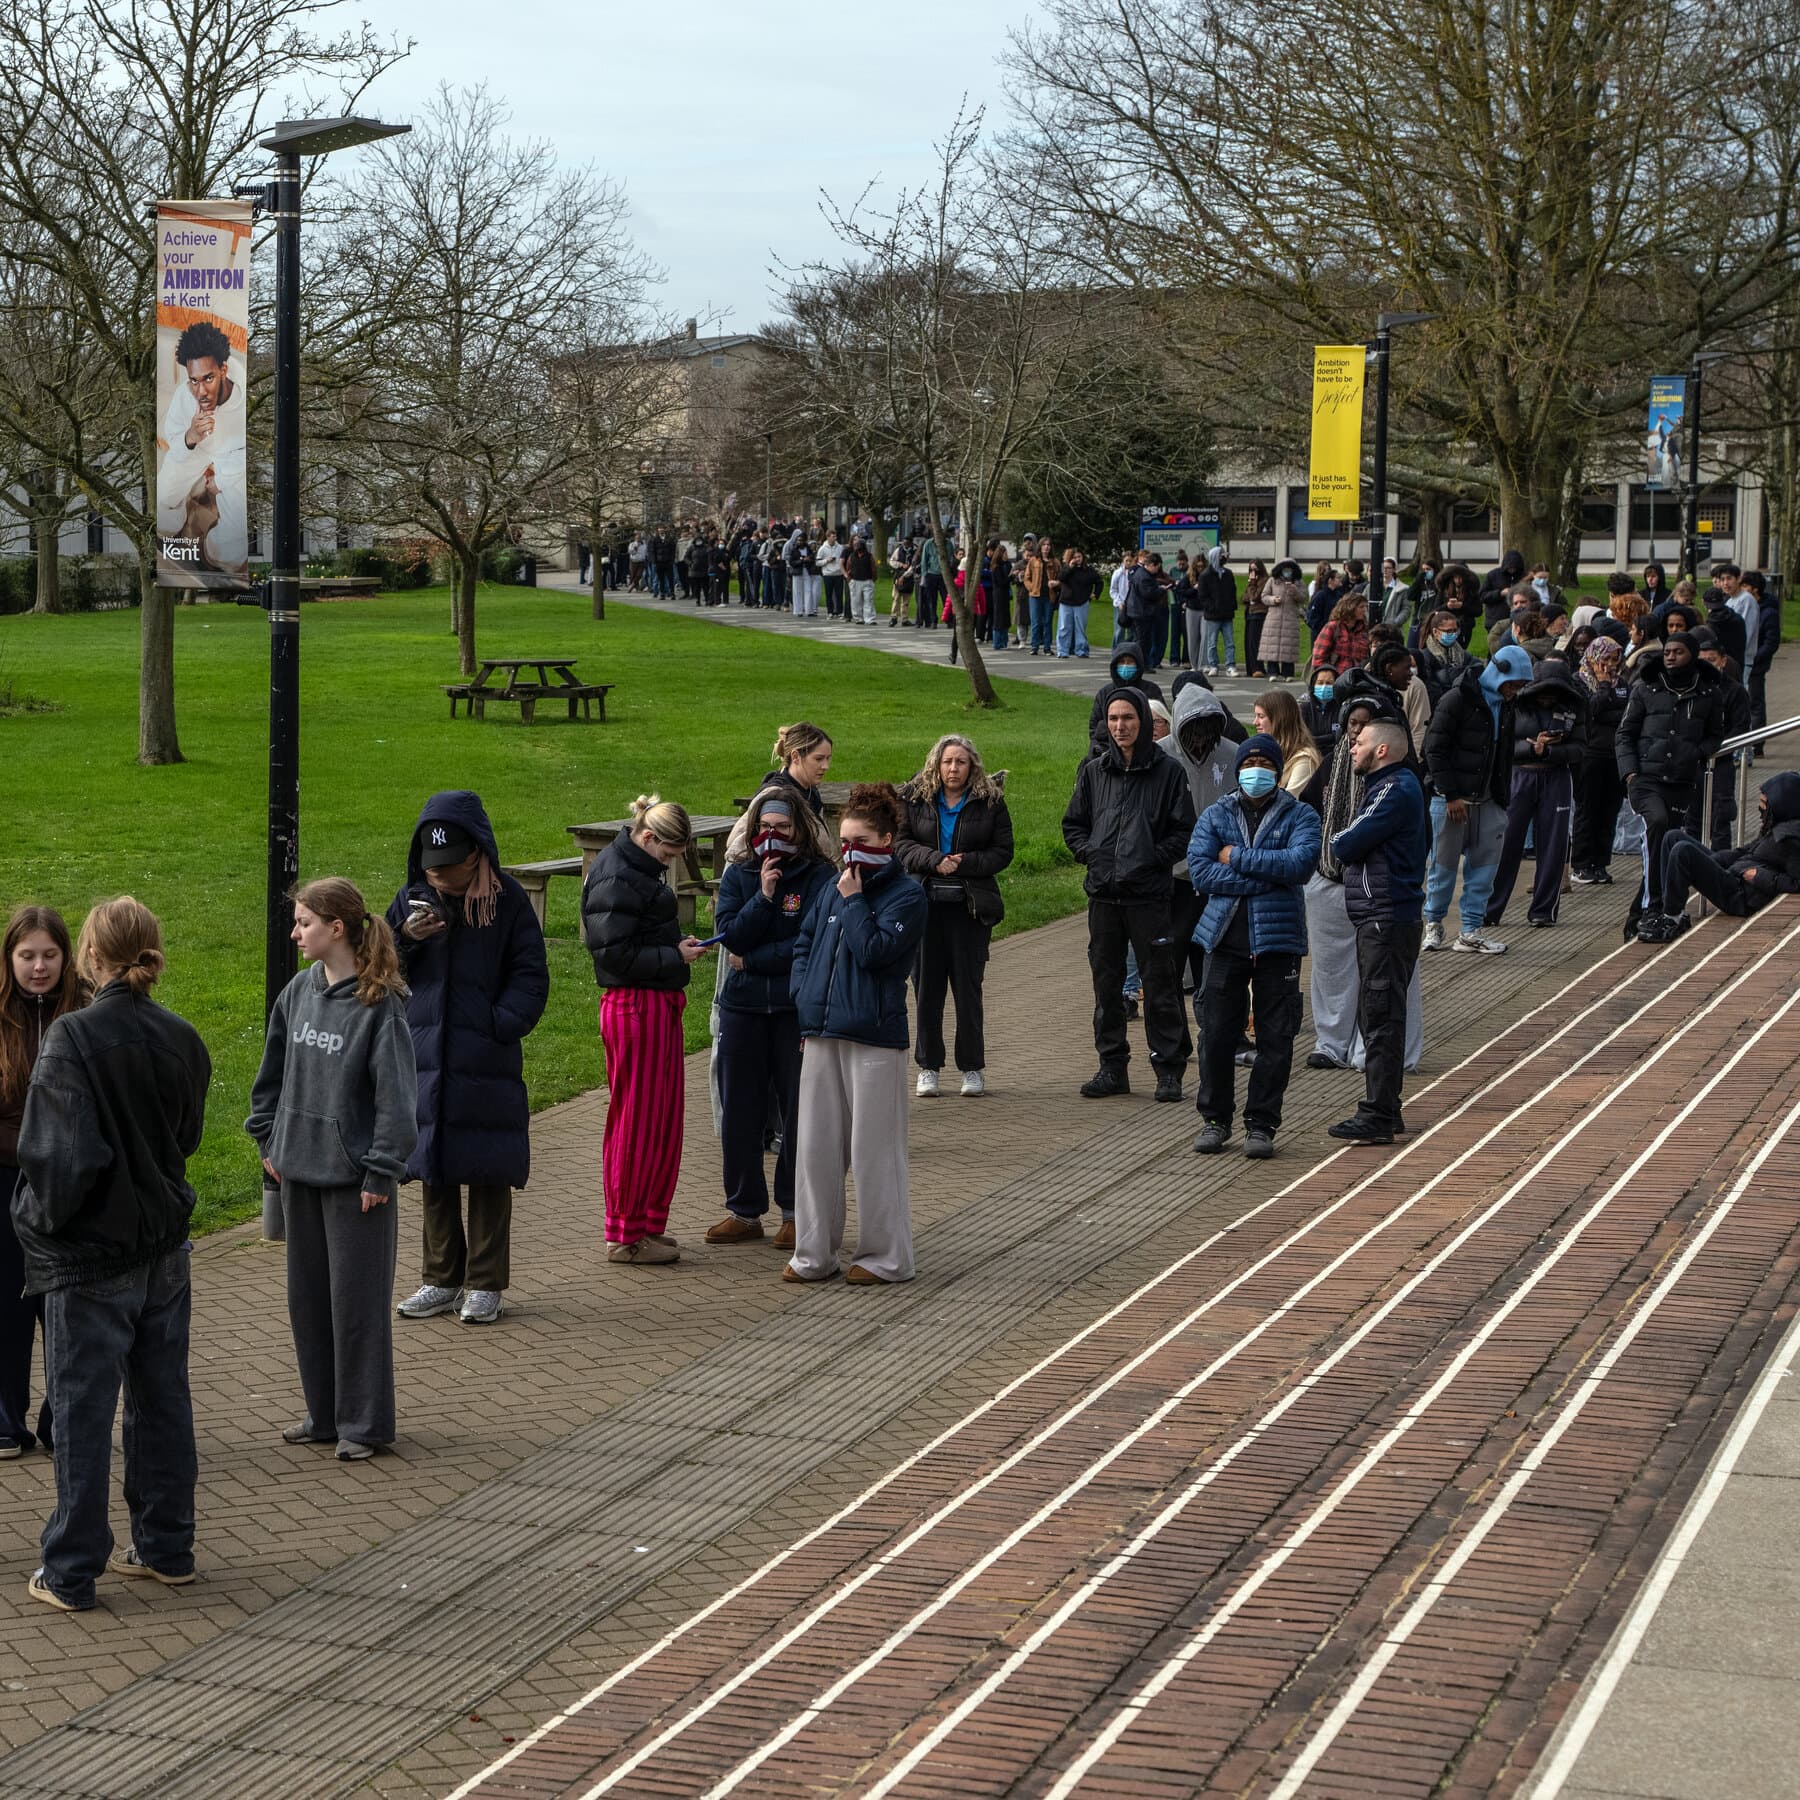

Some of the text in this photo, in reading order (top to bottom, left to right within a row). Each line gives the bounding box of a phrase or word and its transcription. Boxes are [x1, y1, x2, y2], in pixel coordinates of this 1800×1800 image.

[163, 231, 217, 246] Achieve
[163, 252, 195, 268] your
[163, 268, 244, 290] AMBITION
[163, 292, 211, 307] at Kent
[1317, 359, 1350, 367] Ambition
[1316, 367, 1343, 375] doesn't
[1315, 384, 1359, 414] perfect
[1318, 474, 1333, 484] just
[1143, 506, 1166, 515] KSU
[1311, 499, 1332, 508] Kent
[163, 536, 200, 545] University of
[163, 544, 200, 560] Kent
[293, 1021, 344, 1055] Jeep
